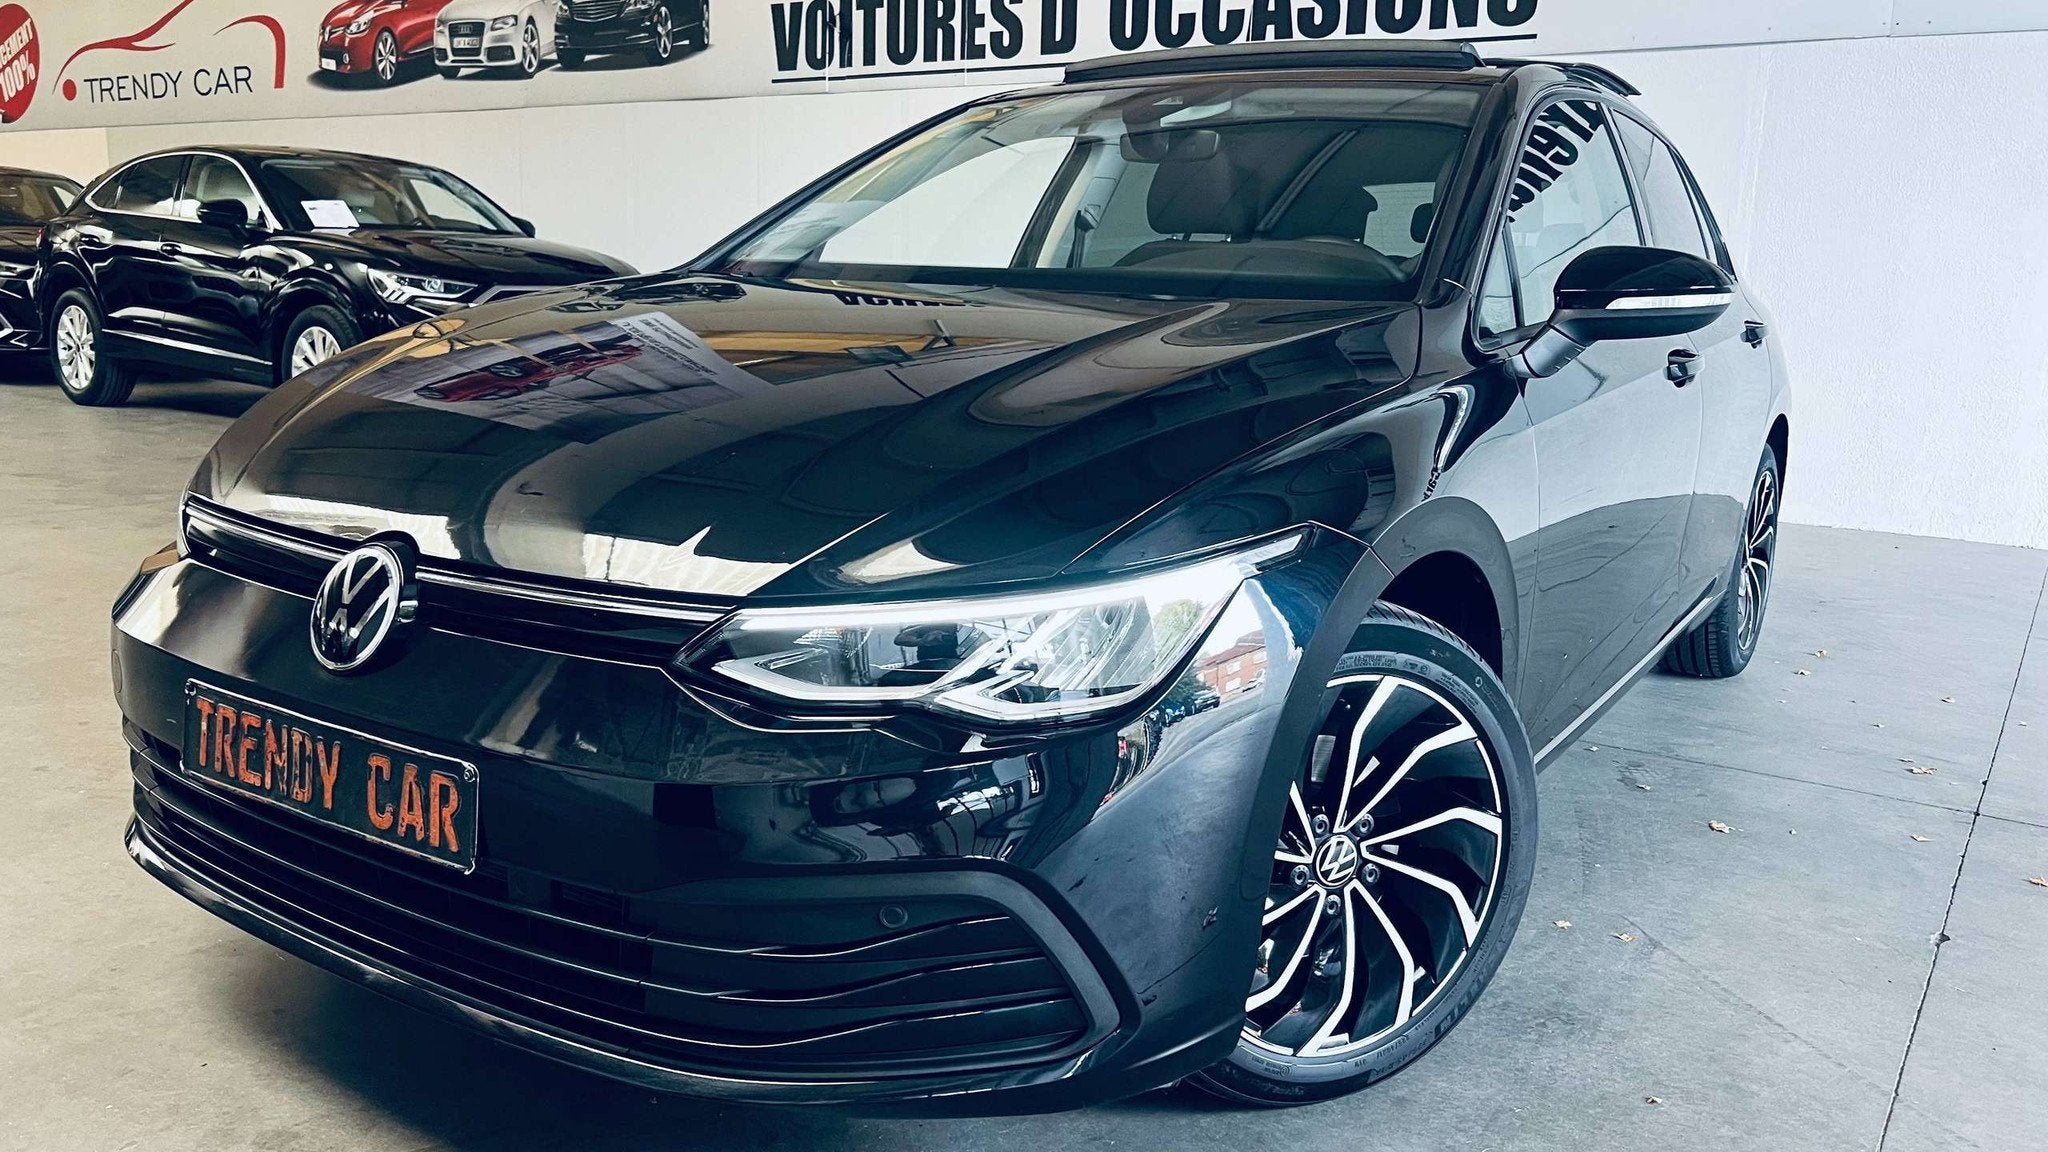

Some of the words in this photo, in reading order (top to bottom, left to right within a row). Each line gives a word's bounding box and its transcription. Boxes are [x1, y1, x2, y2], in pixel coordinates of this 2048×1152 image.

[771, 0, 1023, 71] VOITURES
[0, 50, 36, 102] 100%
[83, 70, 182, 103] TRENDY
[193, 65, 253, 97] CAR
[196, 695, 341, 811] TRENDY
[366, 752, 462, 853] CAR
